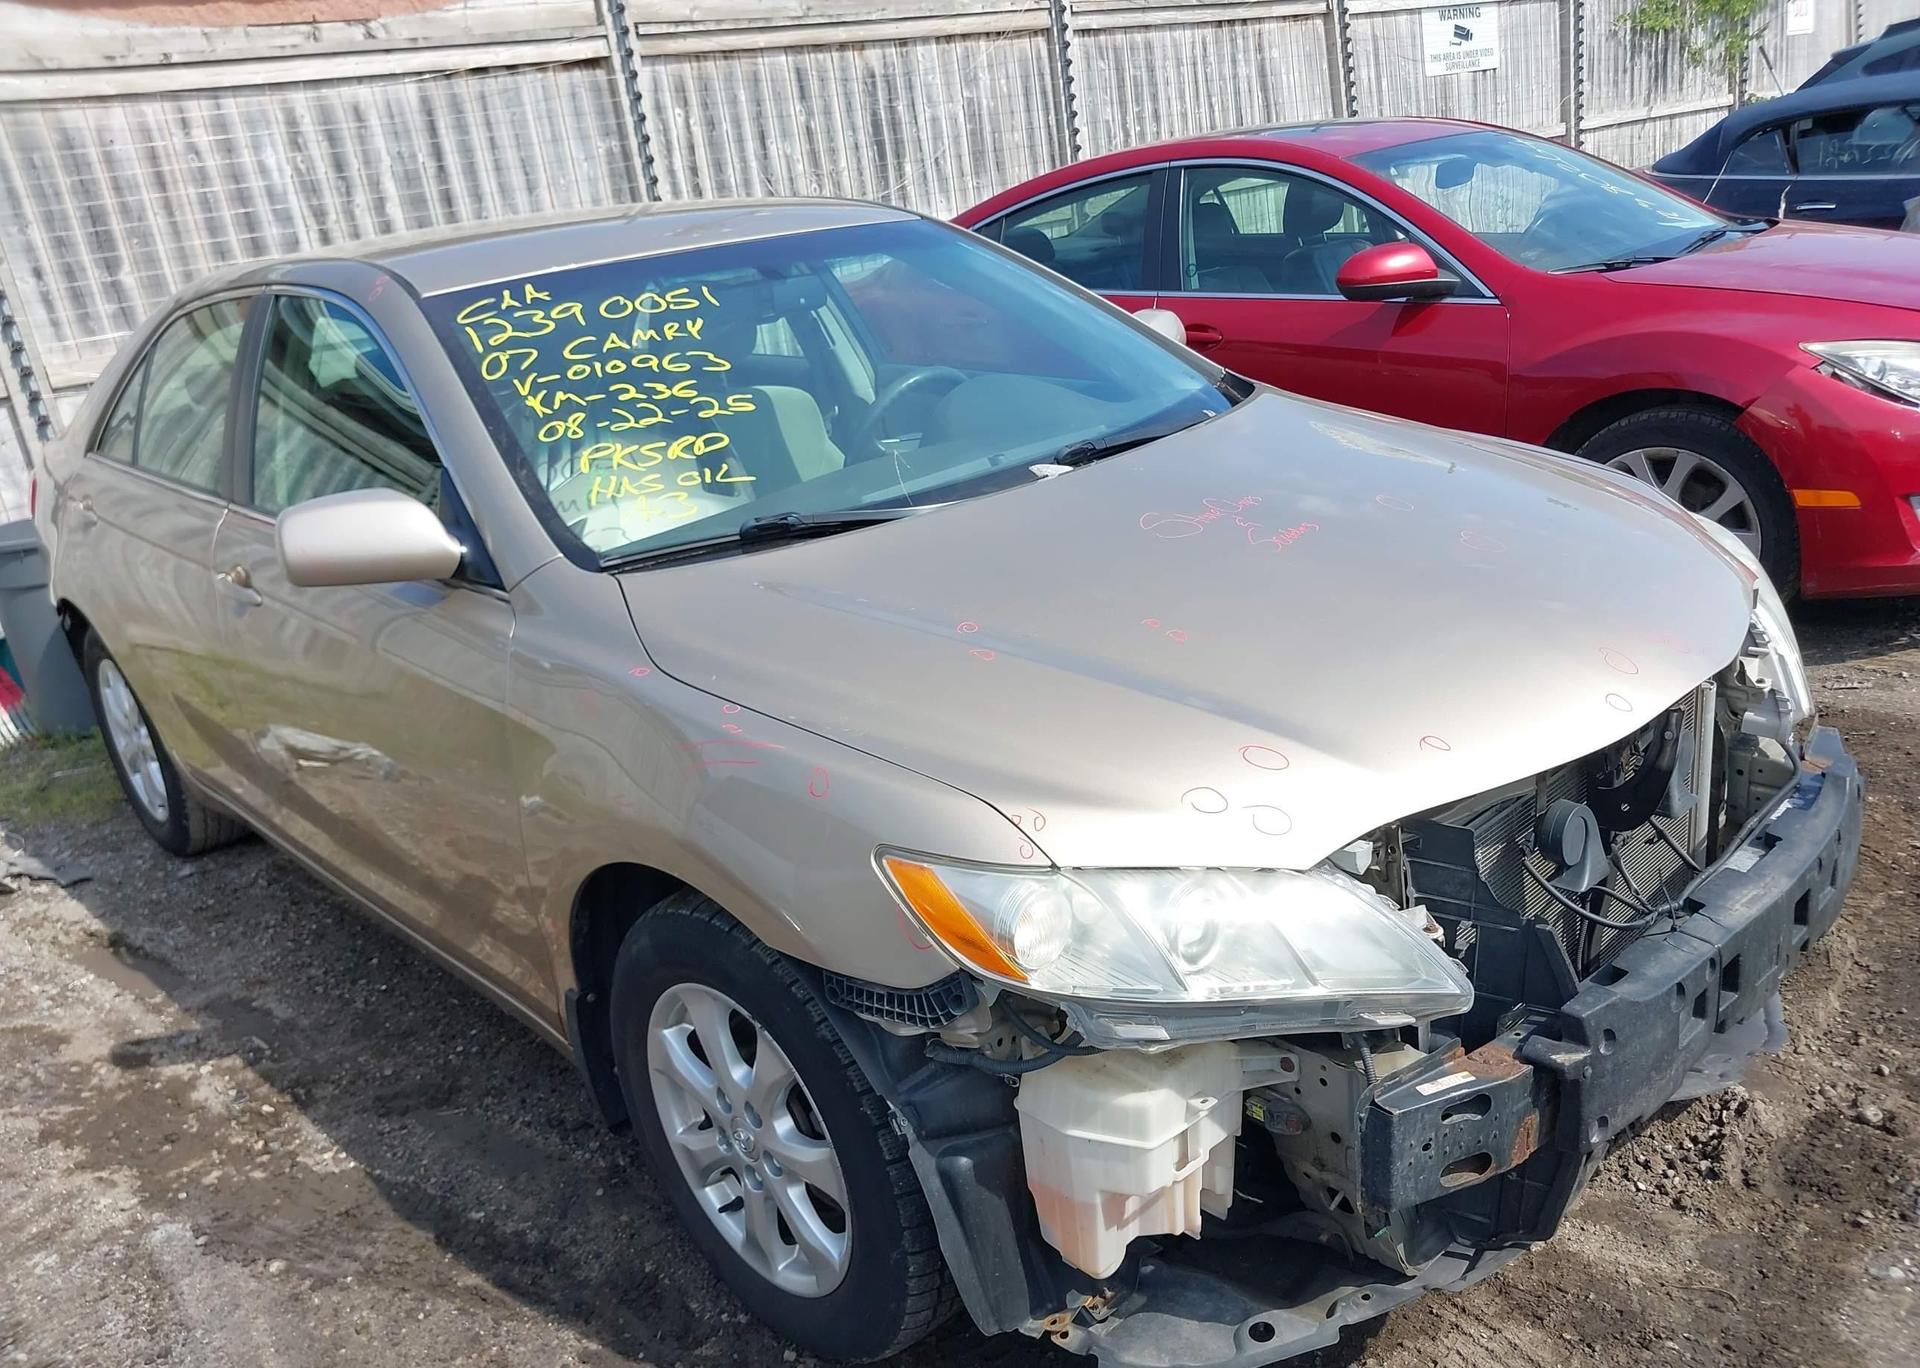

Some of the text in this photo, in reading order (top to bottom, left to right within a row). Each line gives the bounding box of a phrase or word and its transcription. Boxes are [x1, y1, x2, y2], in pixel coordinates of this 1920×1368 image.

[1438, 6, 1481, 21] WARNING
[1430, 53, 1442, 62] THIS
[1443, 51, 1456, 62] AREA
[1457, 51, 1462, 60] IS
[1463, 49, 1479, 60] UNDER
[1445, 59, 1480, 71] SURVEILLANCE
[465, 285, 720, 354] 1239 0051
[481, 316, 705, 381] 07 CAMRY
[676, 462, 757, 486] OIL
